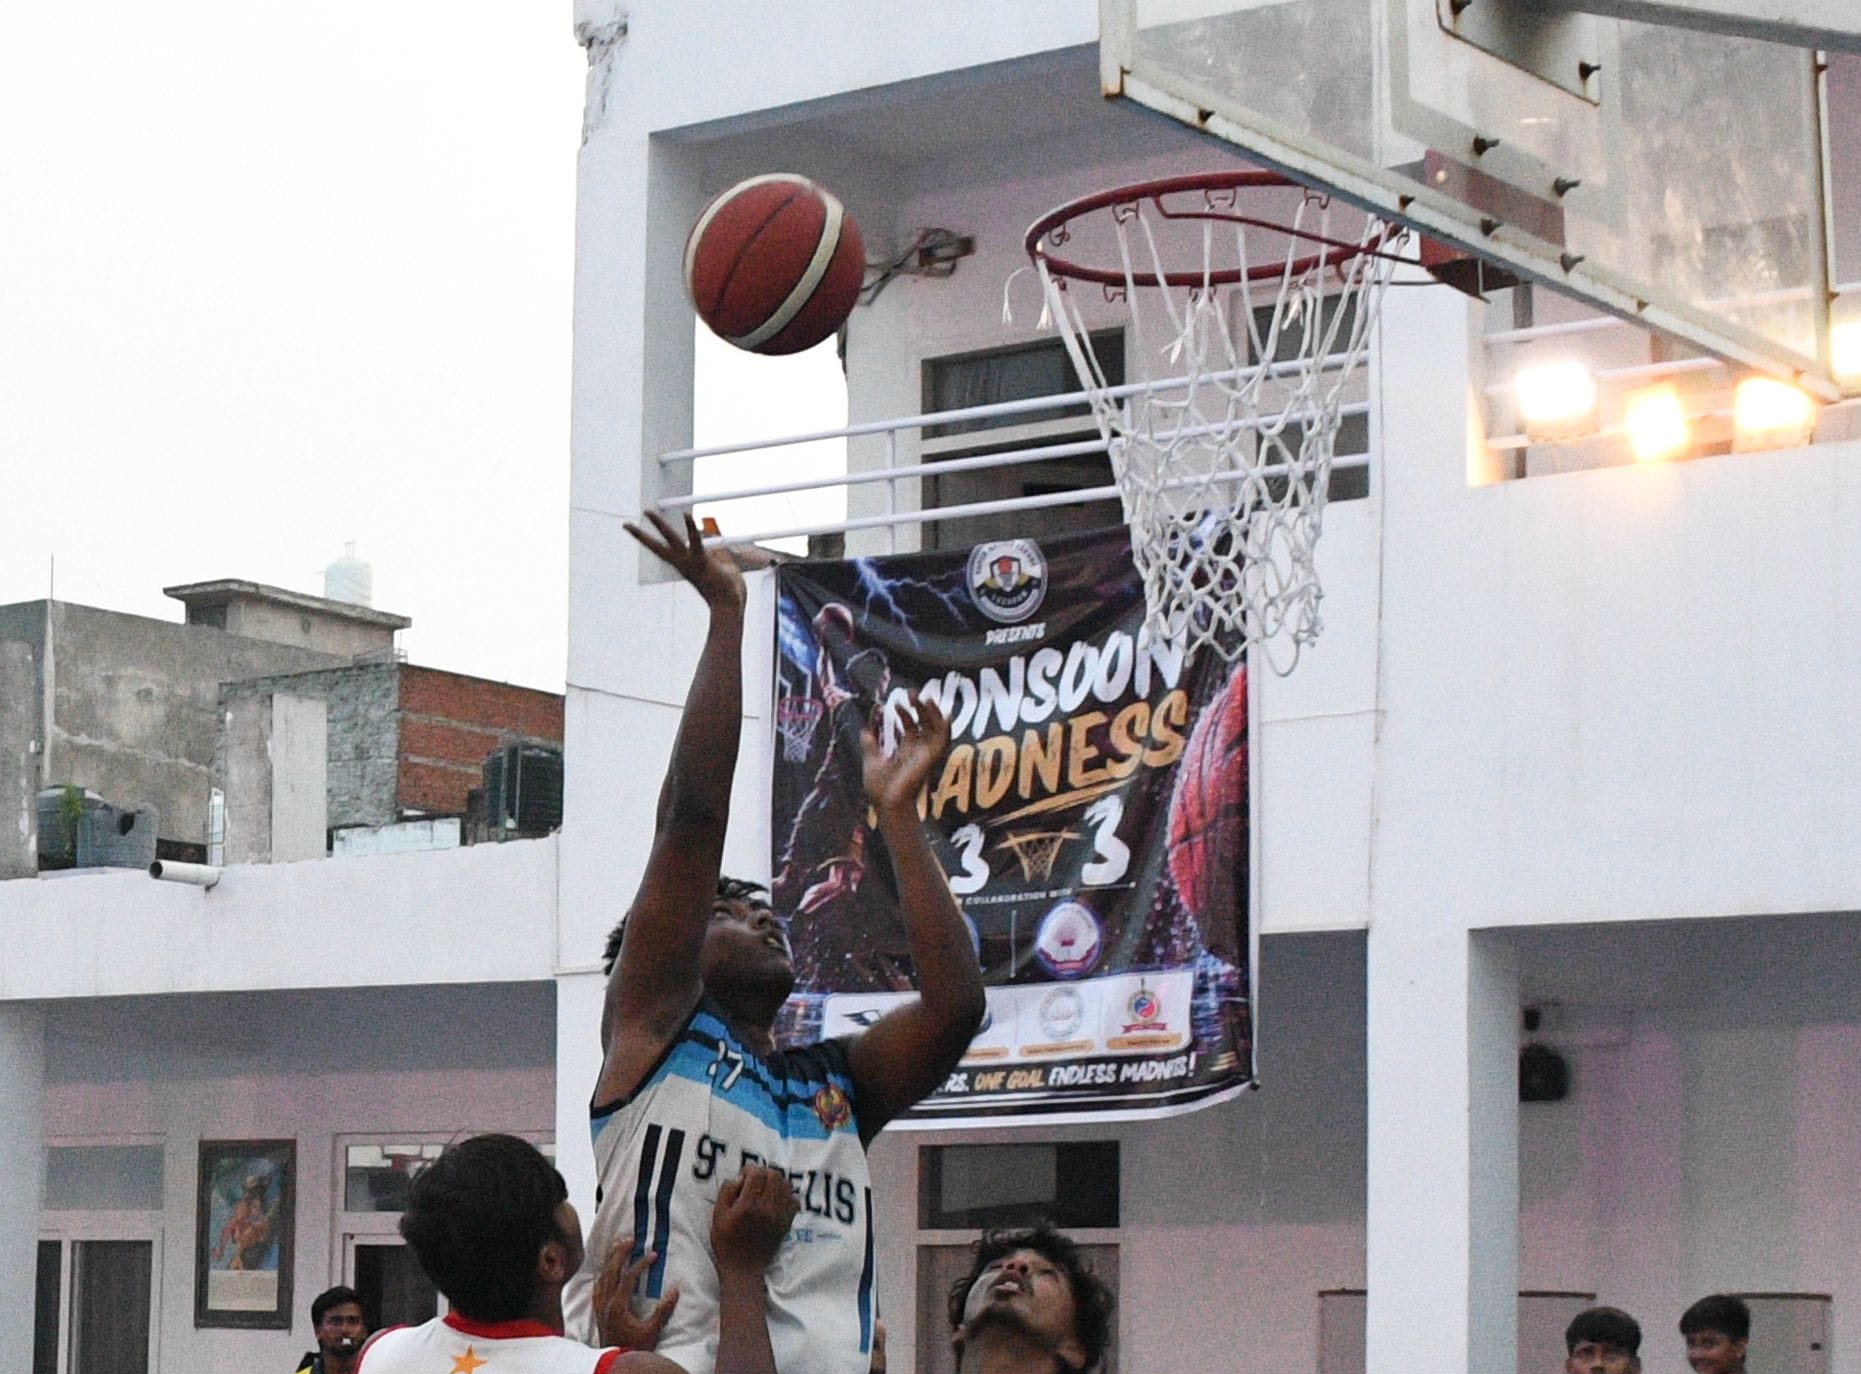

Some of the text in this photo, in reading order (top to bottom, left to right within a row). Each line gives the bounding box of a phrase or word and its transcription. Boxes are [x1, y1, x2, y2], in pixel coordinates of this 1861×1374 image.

[984, 622, 1047, 645] PRESENTS
[866, 690, 1188, 829] ADNESS
[950, 794, 1131, 894] 3 3
[974, 1070, 1007, 1092] ONE
[1048, 1062, 1118, 1087] ENDLESS
